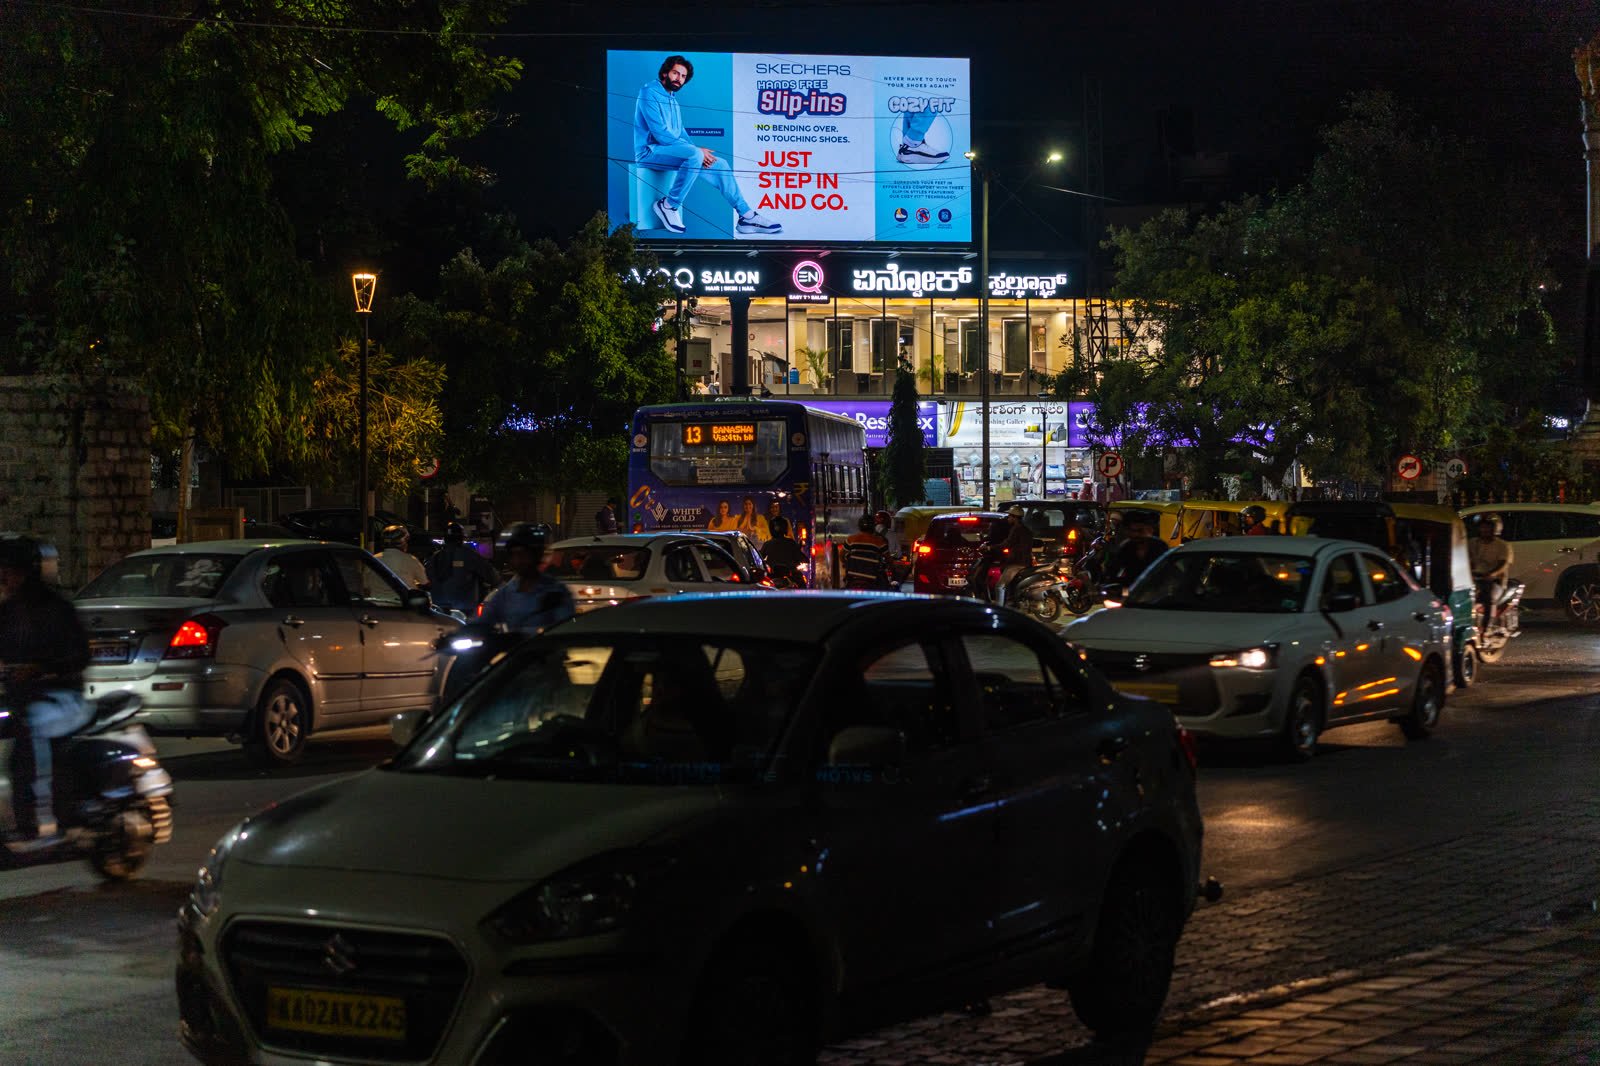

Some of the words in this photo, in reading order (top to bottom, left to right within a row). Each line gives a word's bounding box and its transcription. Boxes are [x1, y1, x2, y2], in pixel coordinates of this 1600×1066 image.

[756, 63, 851, 76] SKECHERS
[756, 79, 797, 90] HANDS
[798, 79, 828, 90] FREE
[759, 89, 846, 117] Slip-ins
[887, 95, 929, 113] COZY
[929, 96, 956, 113] FIT
[772, 124, 811, 132] BENDING
[813, 125, 839, 133] OVER.
[772, 135, 817, 143] TOUCHING
[758, 151, 812, 168] JUST
[758, 171, 812, 189] STEP
[816, 172, 838, 189] IN
[757, 193, 806, 210] AND
[810, 193, 848, 210] GO.
[701, 270, 760, 284] SALON
[686, 425, 702, 444] 13
[672, 515, 696, 523] GOLD
